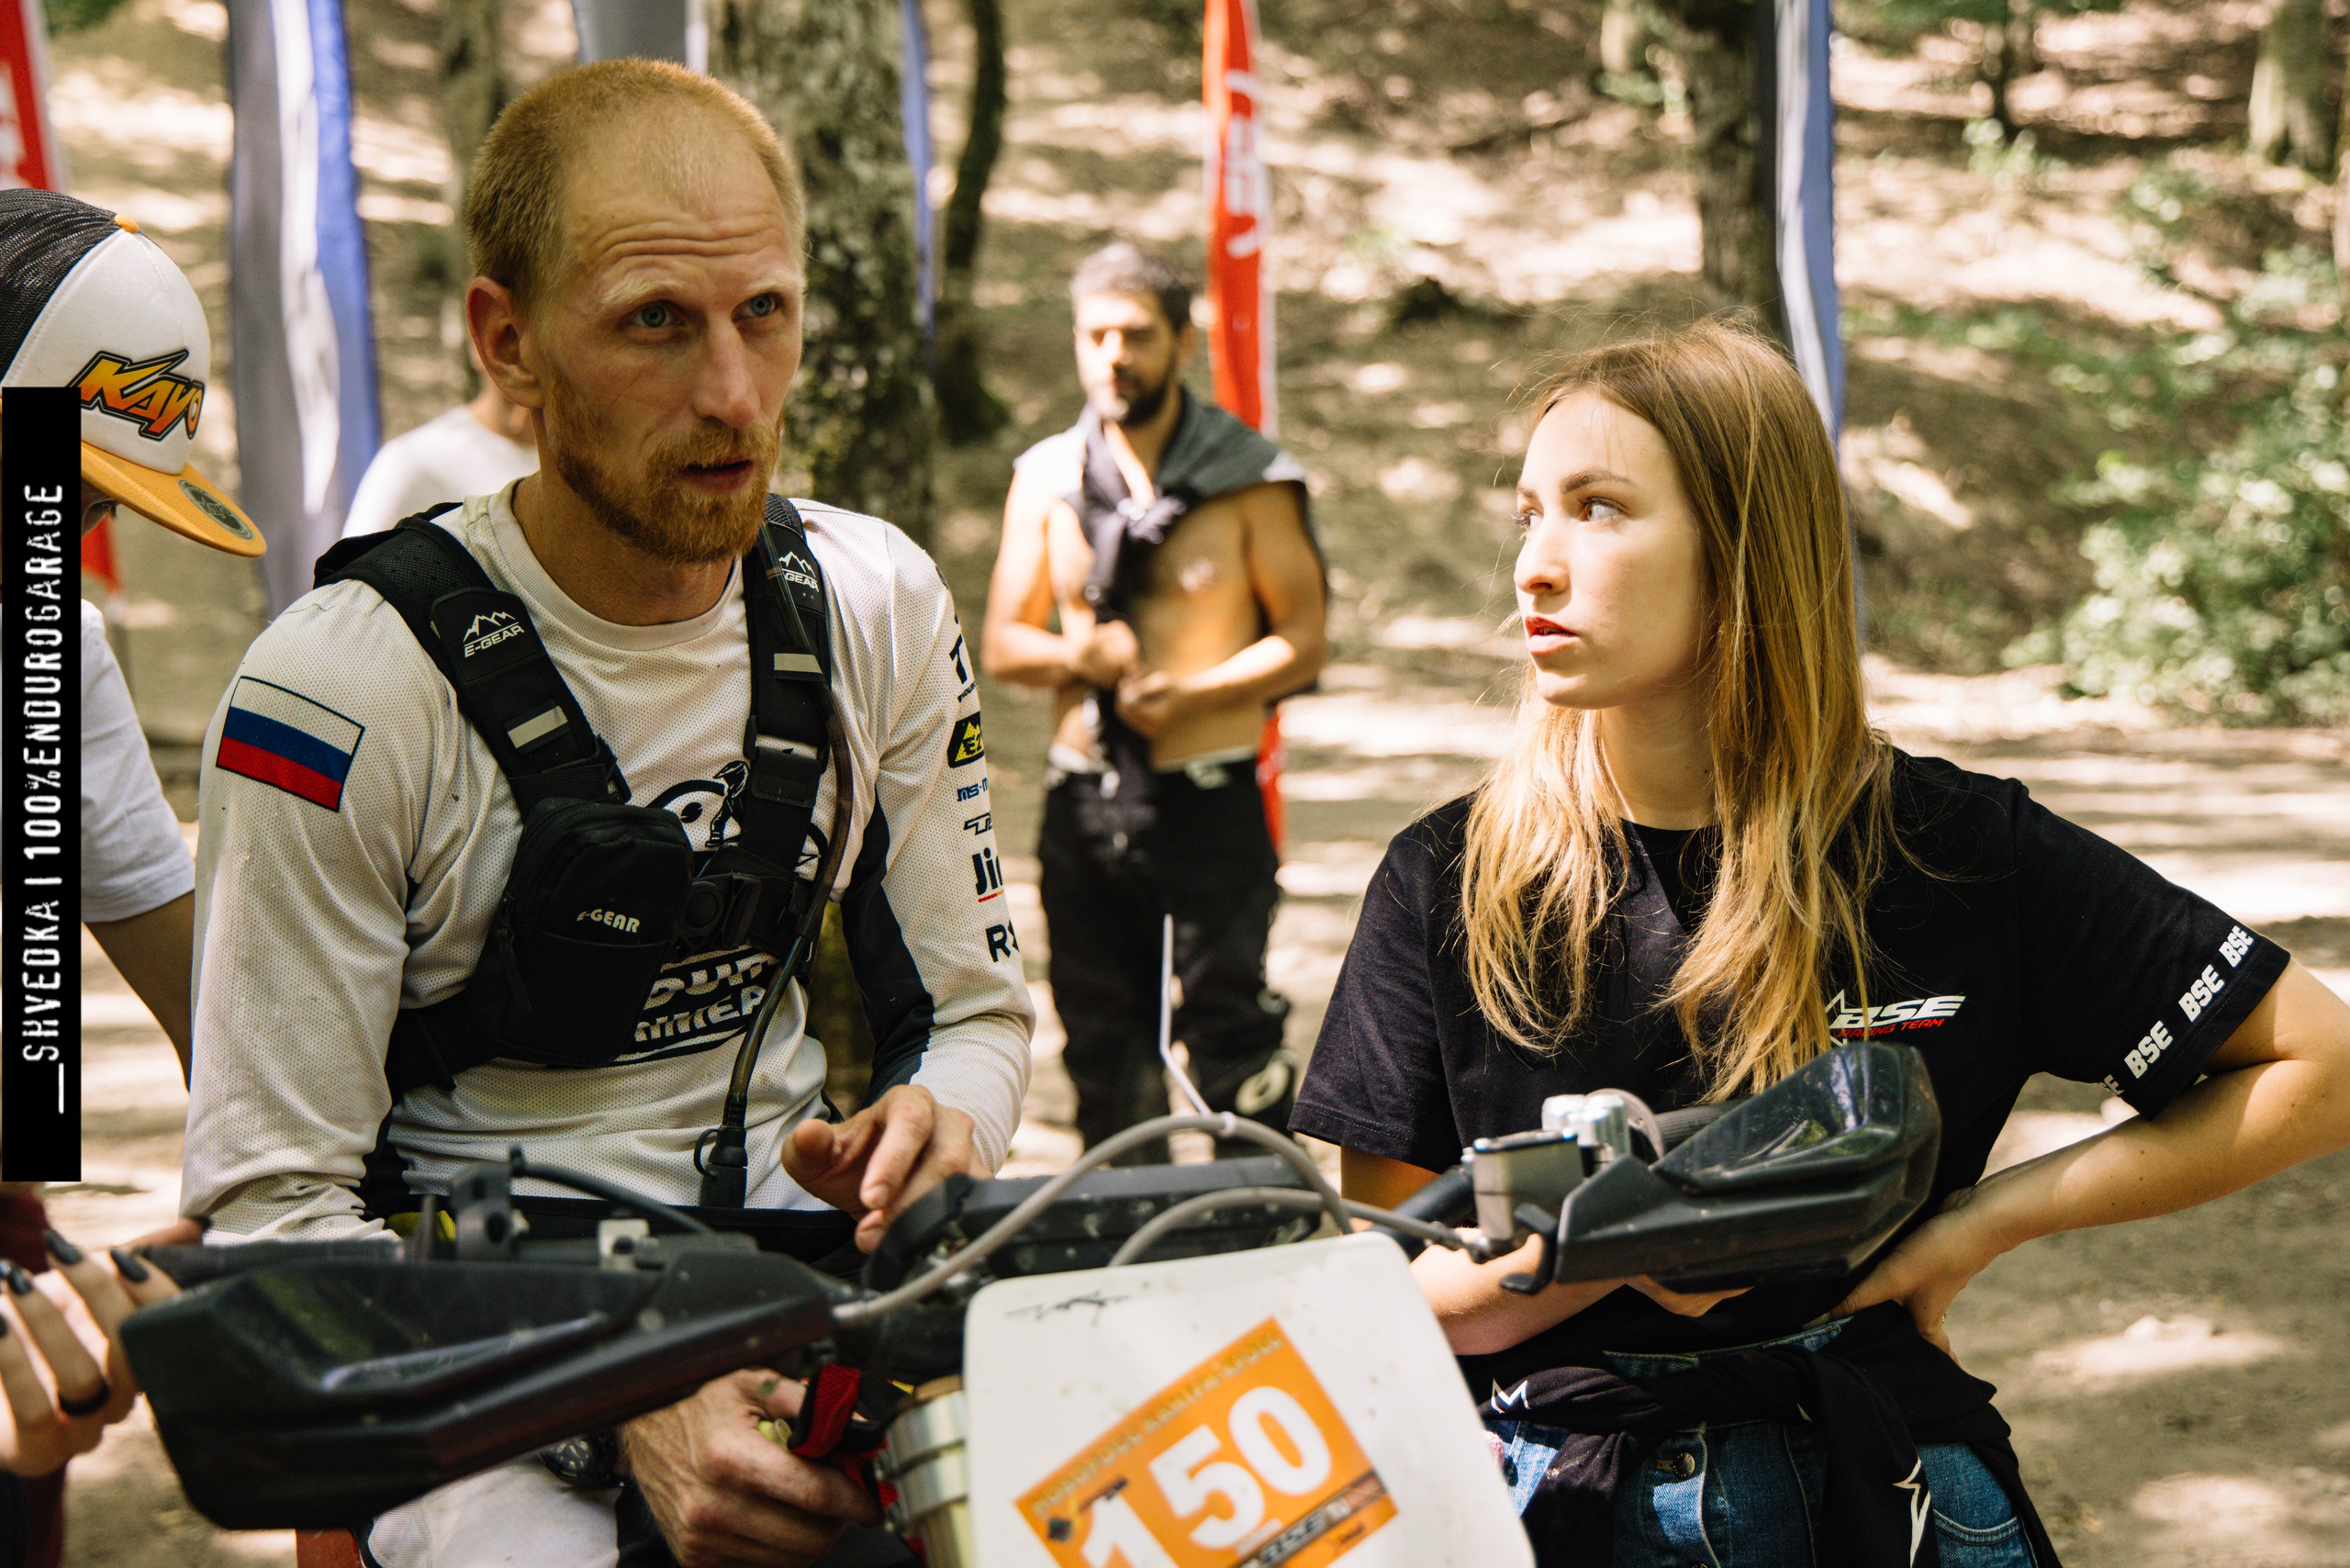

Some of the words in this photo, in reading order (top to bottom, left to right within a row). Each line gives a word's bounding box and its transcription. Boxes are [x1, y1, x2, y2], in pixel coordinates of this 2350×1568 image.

[785, 572, 820, 592] GEAR
[464, 624, 525, 658] E-GEAR
[576, 908, 641, 934] E-GEAR
[2219, 925, 2254, 968] BSE
[2178, 964, 2225, 1023] BSE
[1830, 995, 1966, 1029] BSE
[1901, 1018, 1945, 1030] TEAM
[2124, 1020, 2174, 1079] BSE
[1081, 1385, 1332, 1568] 150
